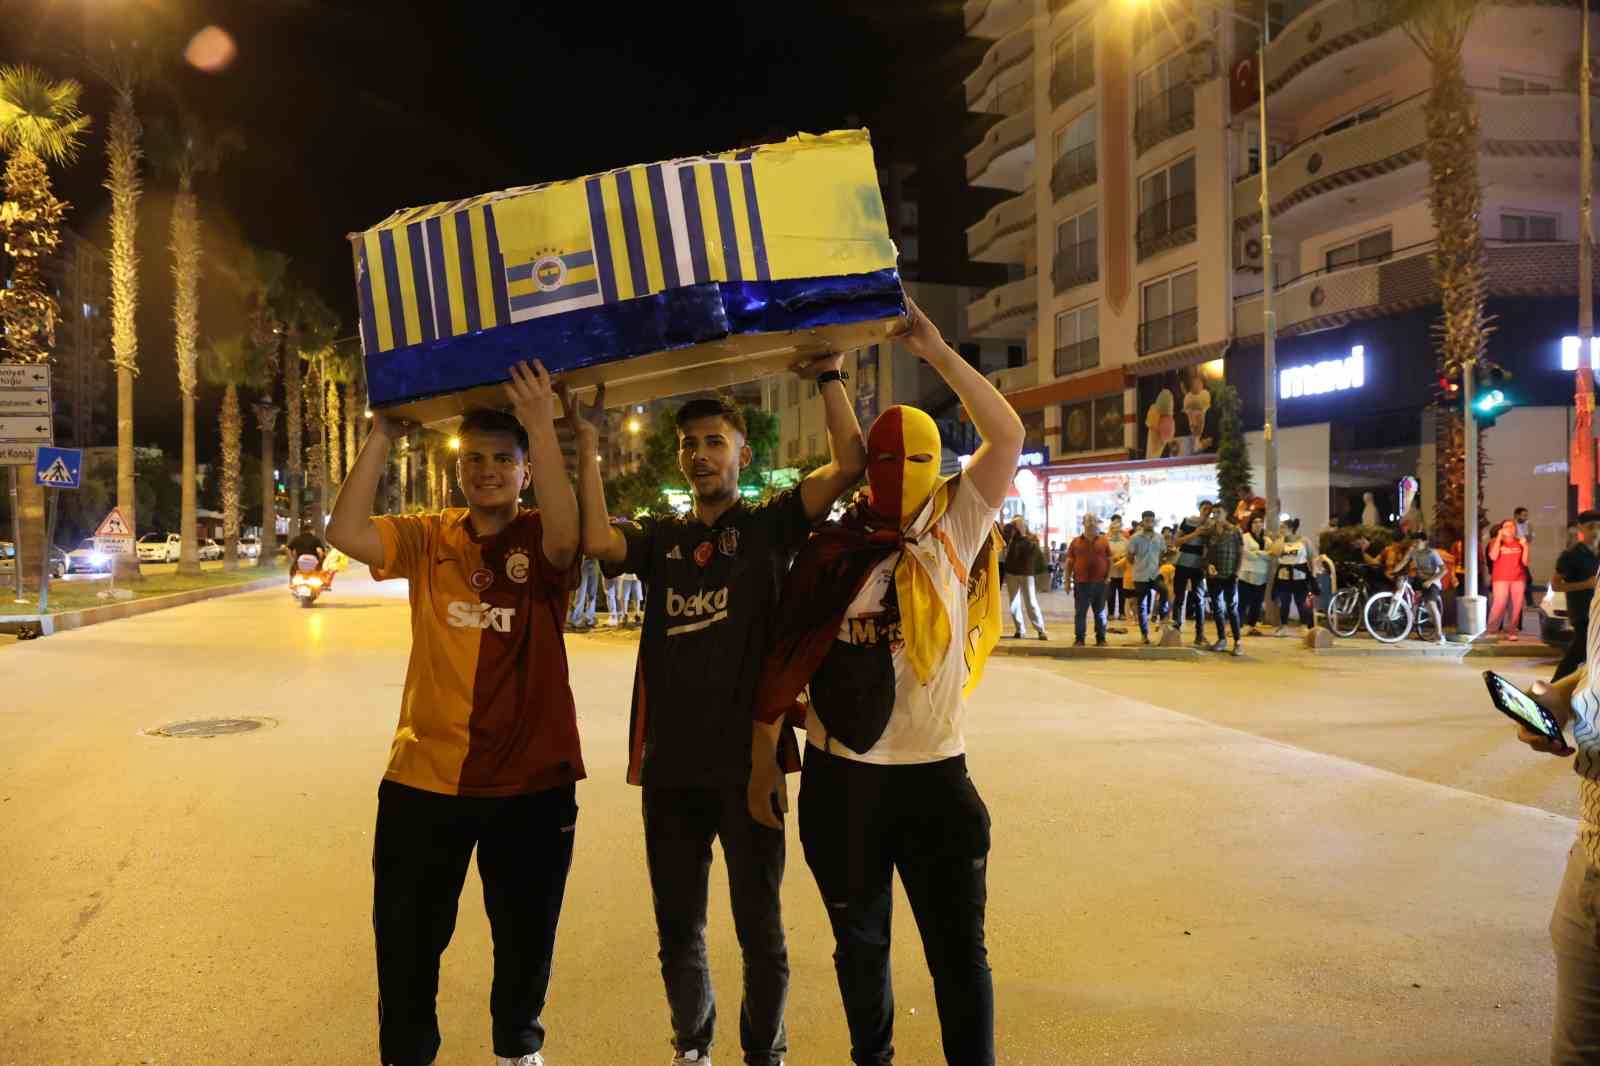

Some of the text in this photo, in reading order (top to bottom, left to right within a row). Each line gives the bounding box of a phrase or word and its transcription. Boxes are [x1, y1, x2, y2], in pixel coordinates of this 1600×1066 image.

[1280, 345, 1364, 400] mavi
[447, 601, 517, 633] SIXT
[665, 585, 729, 617] beko
